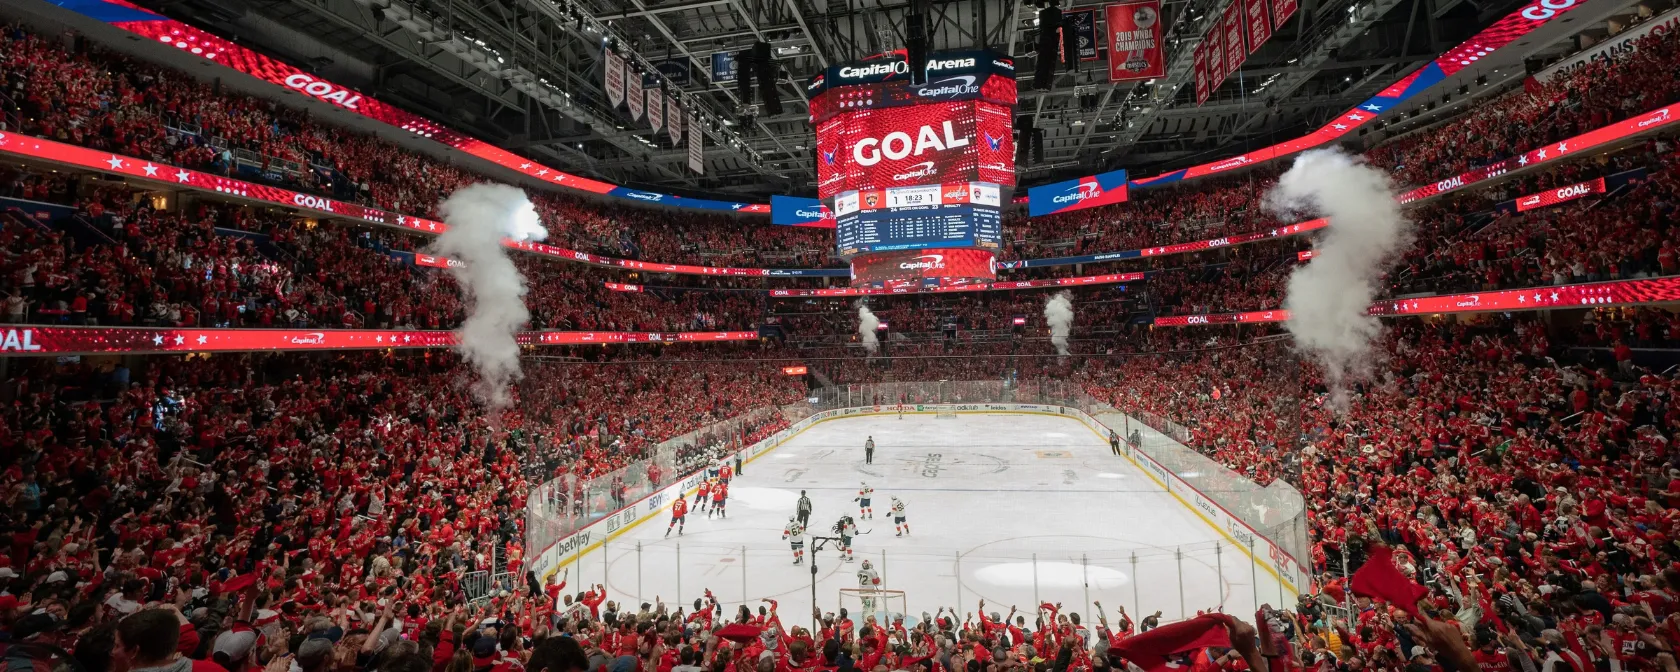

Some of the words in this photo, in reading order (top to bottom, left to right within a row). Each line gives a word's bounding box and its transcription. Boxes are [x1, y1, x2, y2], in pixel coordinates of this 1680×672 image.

[1116, 31, 1132, 42] 2019
[1133, 29, 1153, 40] WNBA
[1115, 38, 1155, 52] CHAMPIONS
[926, 57, 975, 70] Arena
[285, 74, 361, 109] GOAL
[853, 121, 969, 166] GOAL
[1438, 176, 1464, 191] GOAL
[1557, 184, 1586, 198] GOAL
[294, 194, 333, 212] GOAL
[893, 196, 898, 205] 1
[928, 194, 933, 202] 1
[1209, 238, 1230, 247] GOAL
[574, 252, 589, 261] GOAL
[447, 259, 464, 268] GOAL
[1188, 316, 1208, 324] GOAL
[647, 333, 660, 341] GOAL
[859, 575, 868, 585] 72
